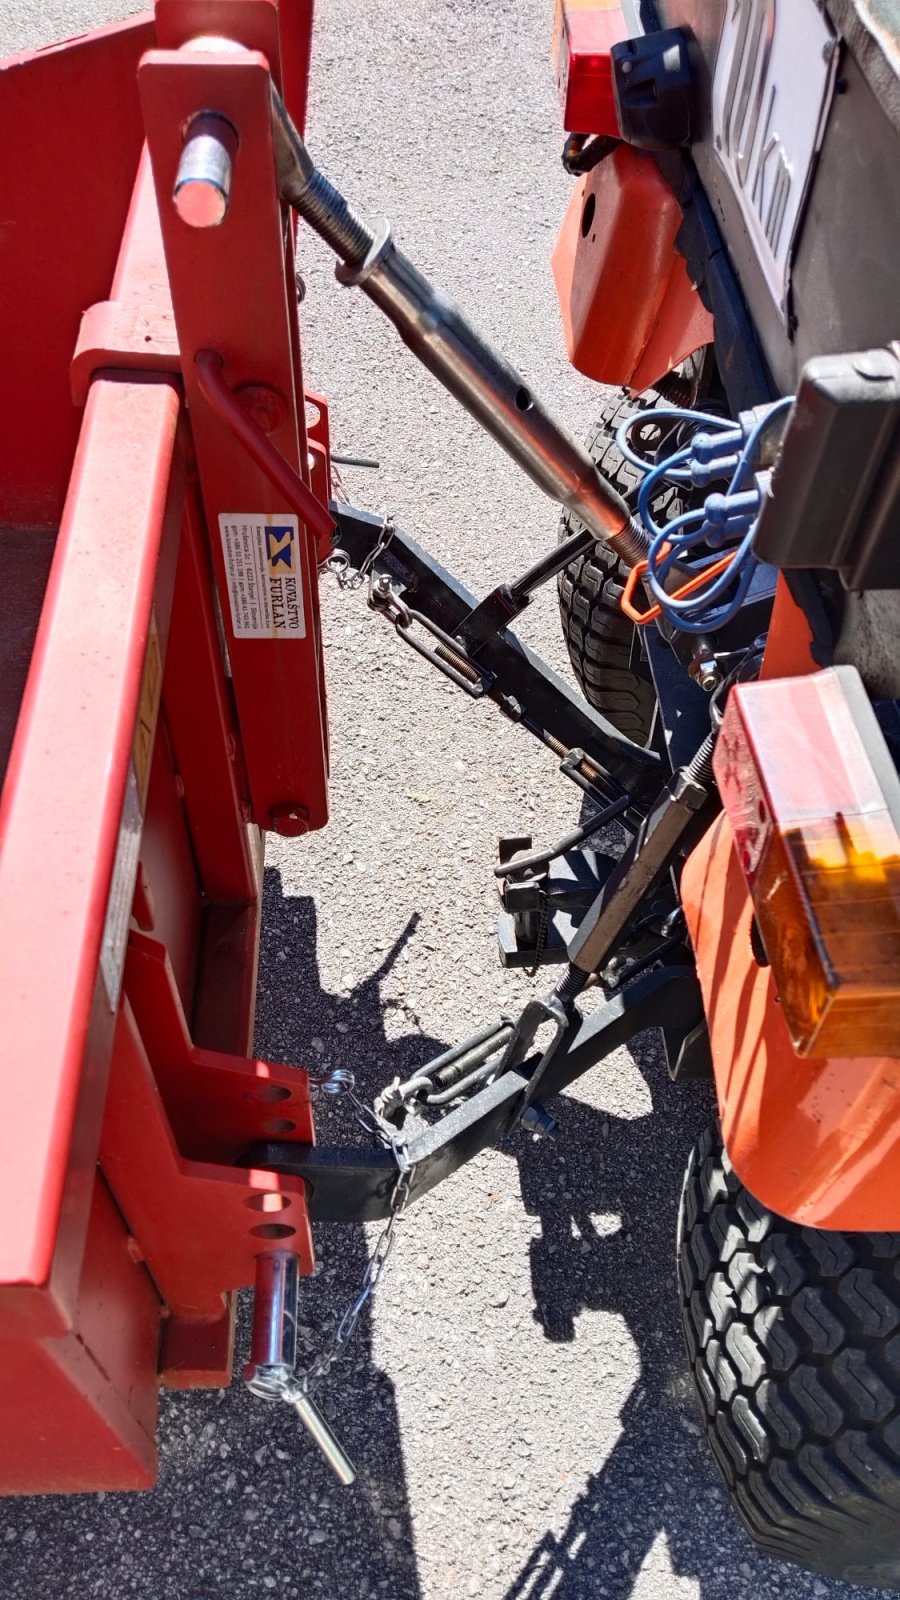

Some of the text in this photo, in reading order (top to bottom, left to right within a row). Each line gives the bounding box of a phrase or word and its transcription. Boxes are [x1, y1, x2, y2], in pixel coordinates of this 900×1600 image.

[751, 84, 793, 259] km
[250, 607, 258, 629] Slovenija
[270, 577, 286, 629] FURLAN
[285, 577, 299, 629] KOVAŠTVO
